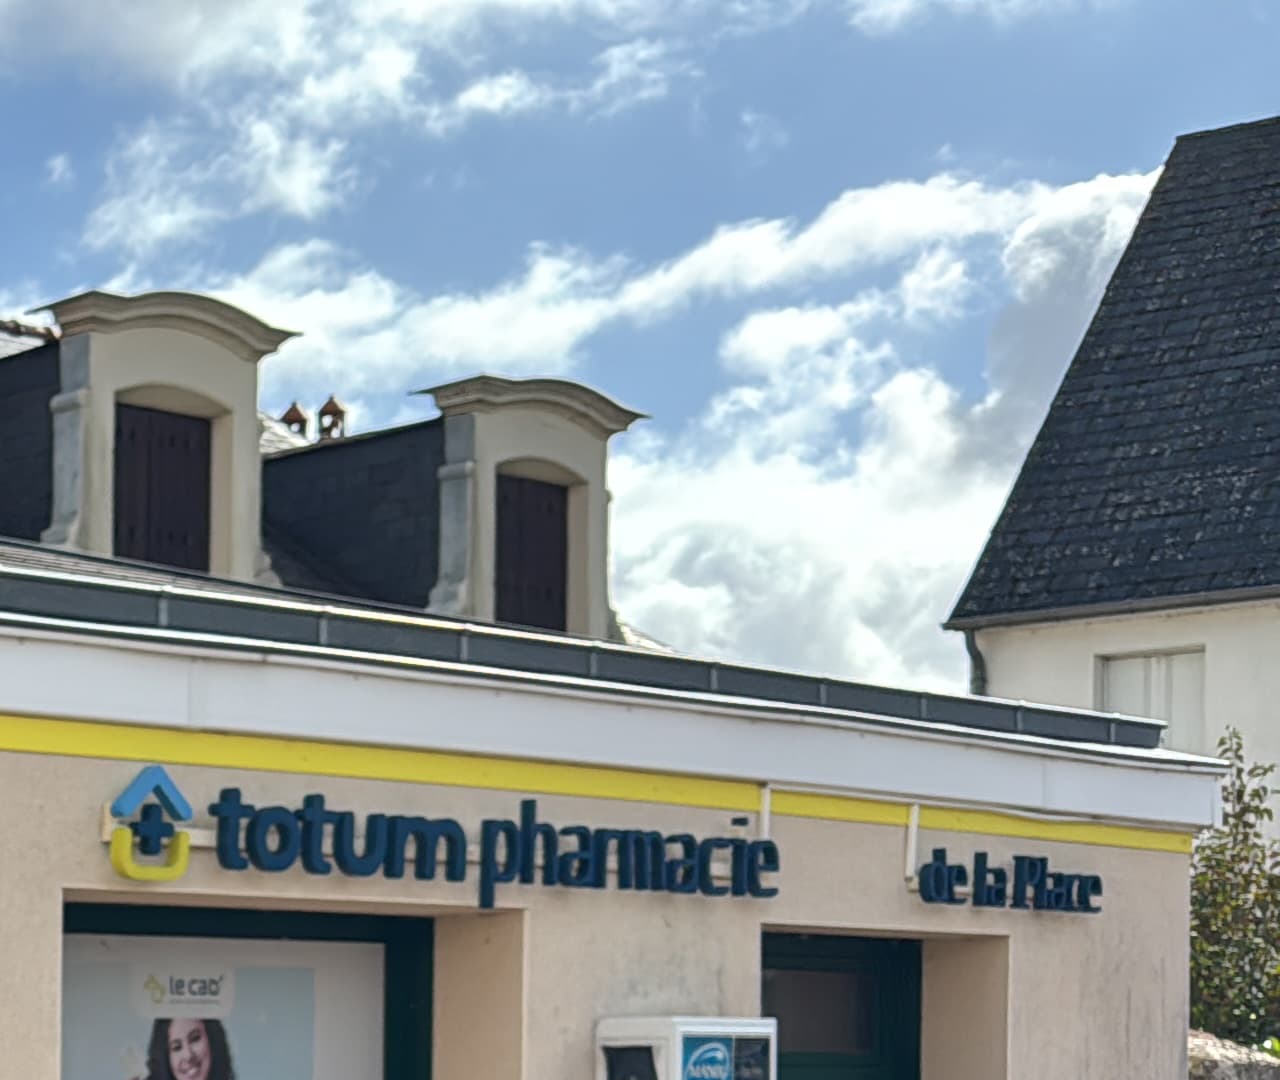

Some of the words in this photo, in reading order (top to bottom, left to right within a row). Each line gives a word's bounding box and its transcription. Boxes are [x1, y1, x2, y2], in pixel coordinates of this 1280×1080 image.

[209, 788, 466, 882] totum
[478, 799, 780, 908] pharmacie
[918, 848, 968, 904] de
[972, 852, 1007, 908] la
[1010, 855, 1103, 914] Place
